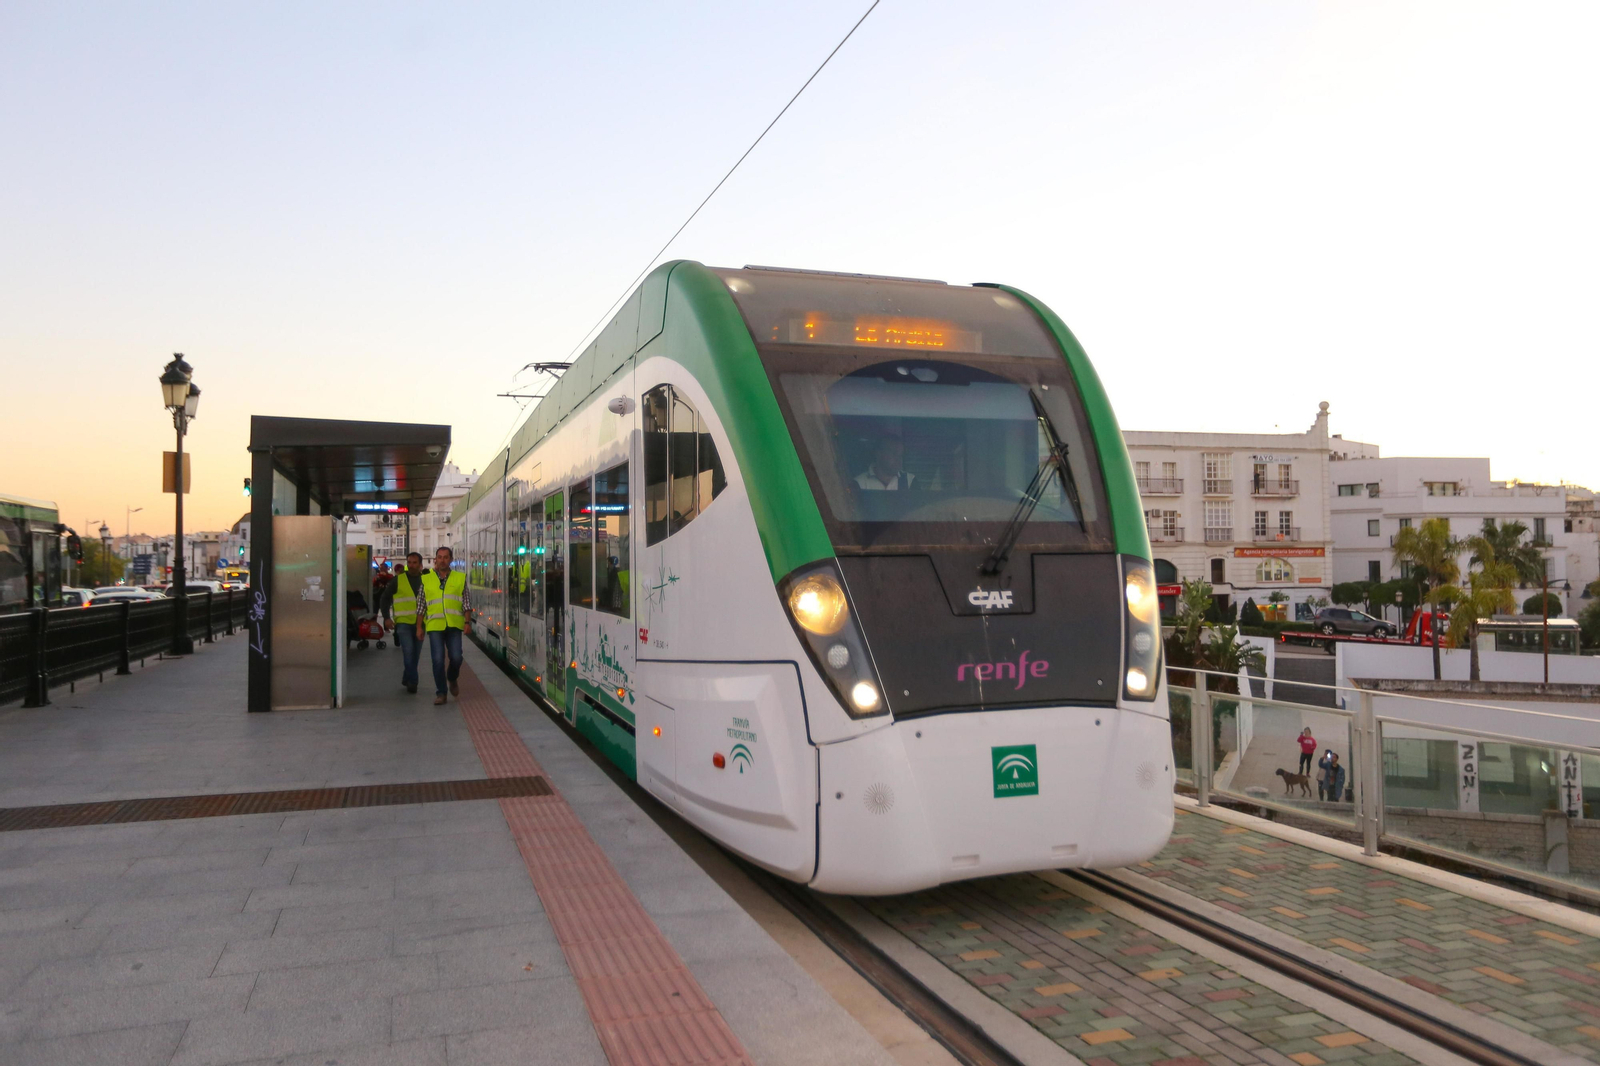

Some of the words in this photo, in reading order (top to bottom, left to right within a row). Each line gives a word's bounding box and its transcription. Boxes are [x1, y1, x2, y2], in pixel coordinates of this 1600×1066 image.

[968, 590, 1014, 609] CAF
[957, 650, 1050, 690] renfe
[726, 727, 758, 743] METROPOLITANO
